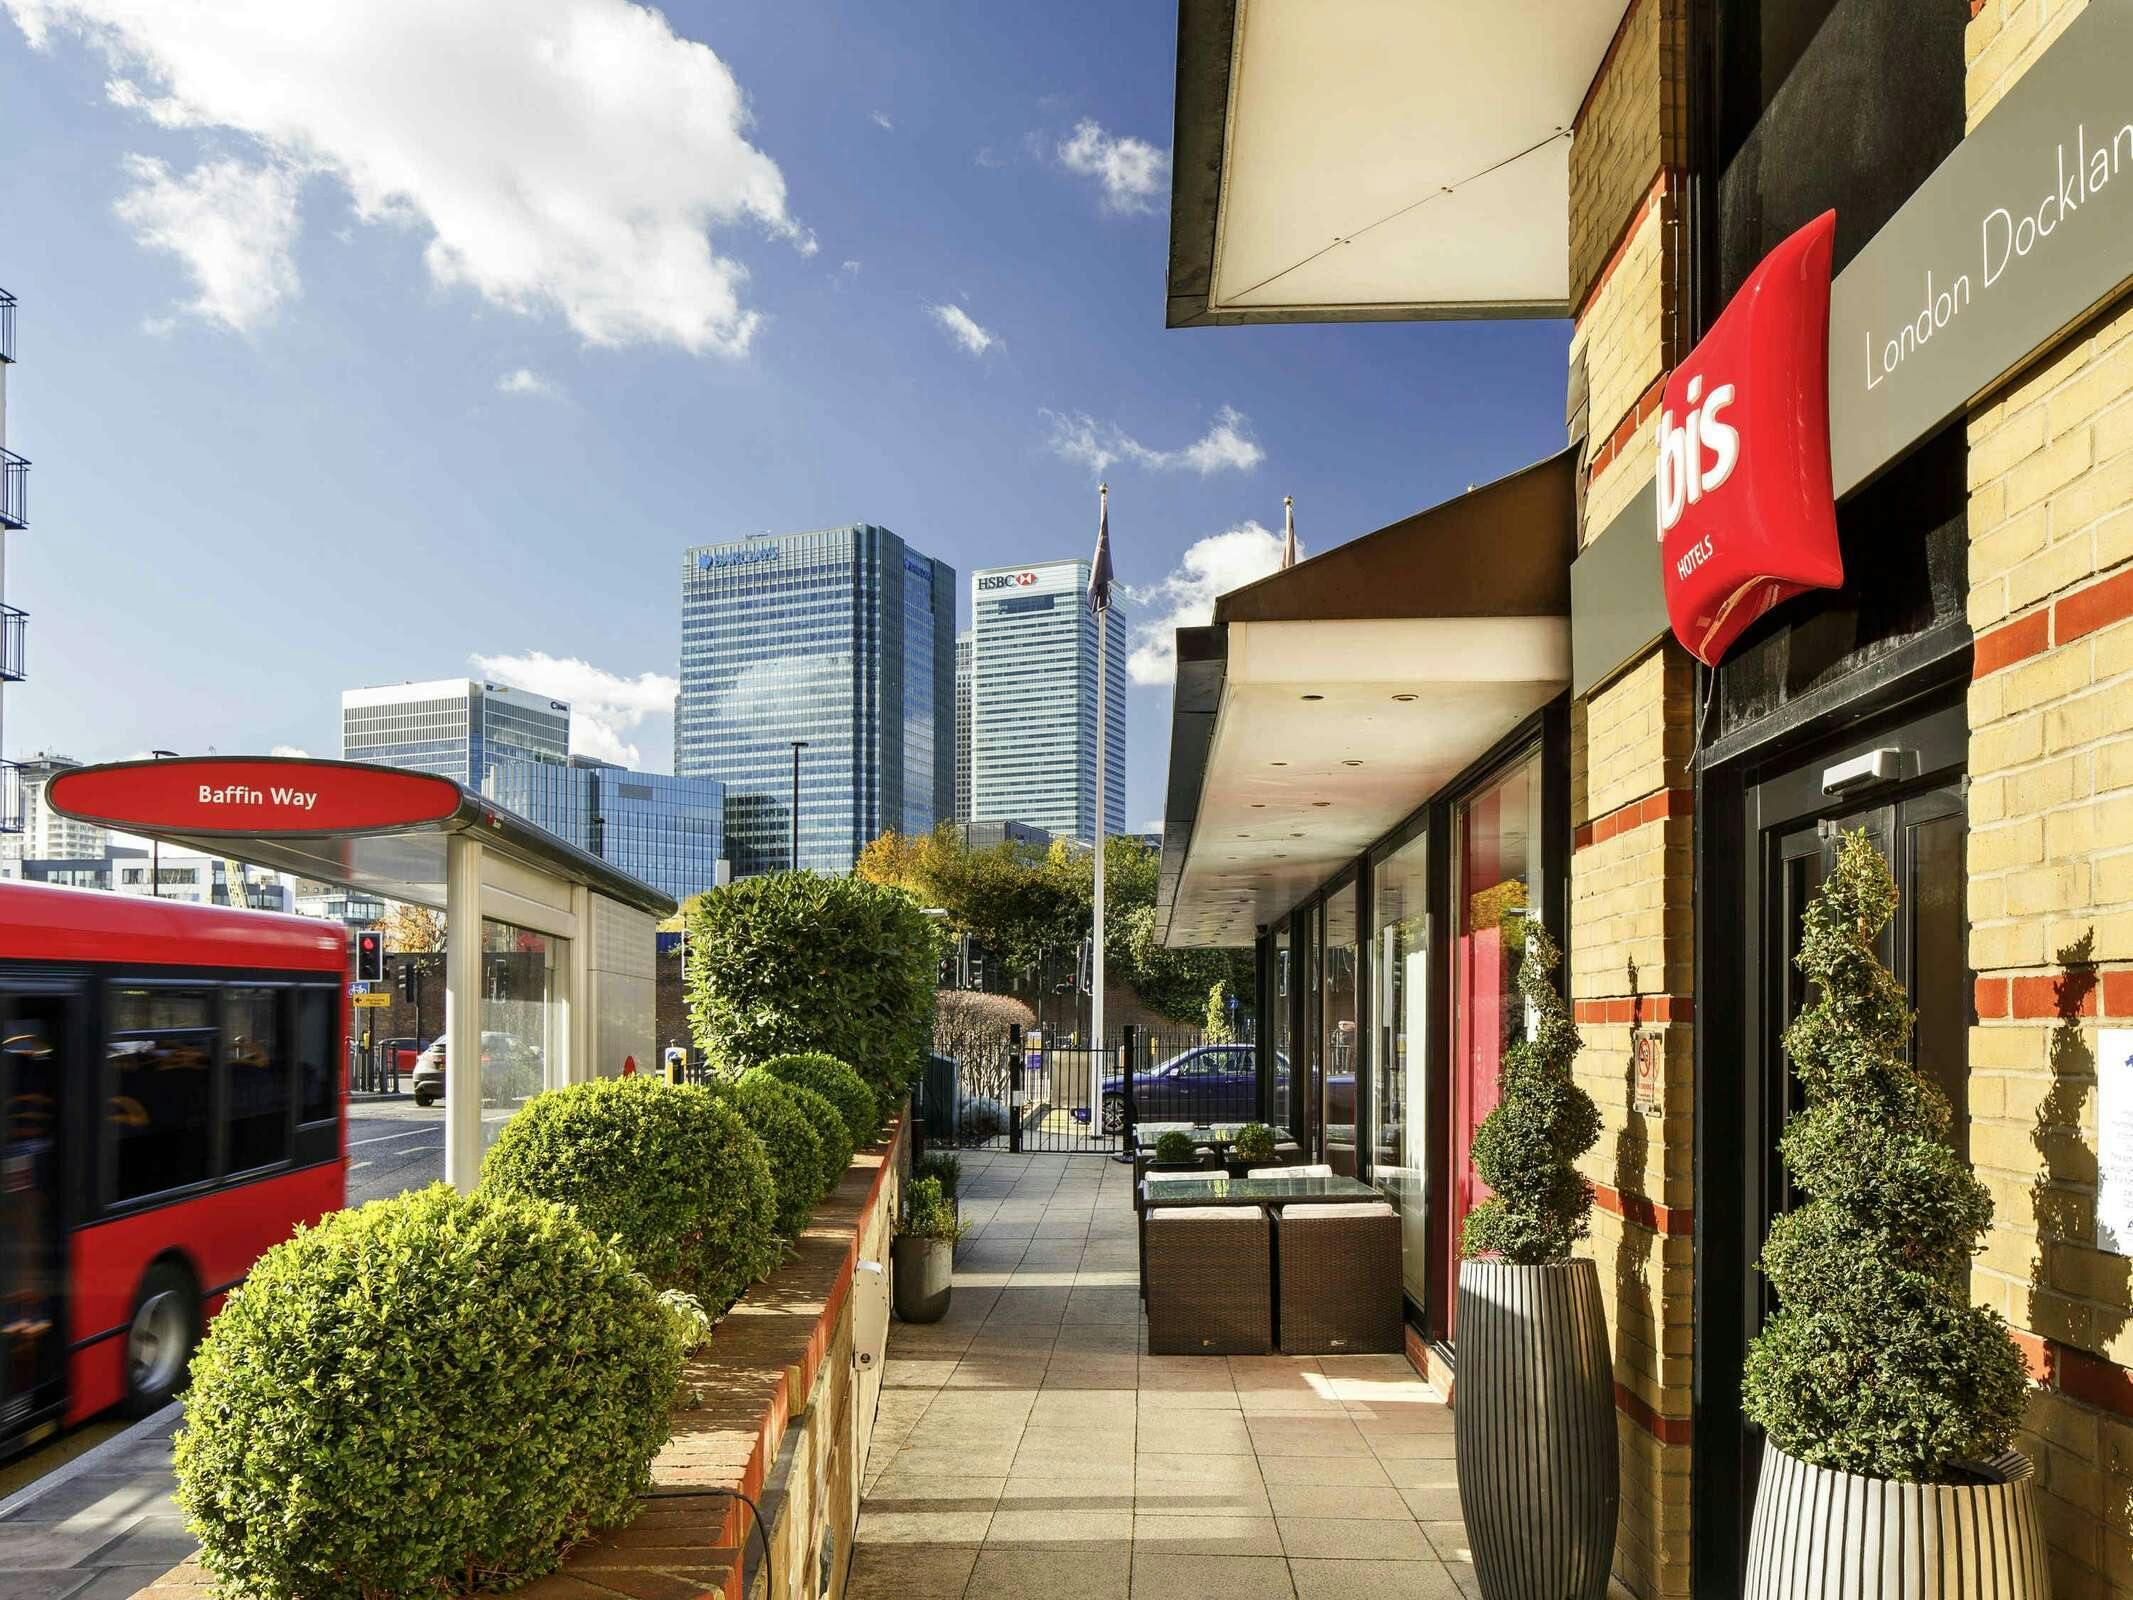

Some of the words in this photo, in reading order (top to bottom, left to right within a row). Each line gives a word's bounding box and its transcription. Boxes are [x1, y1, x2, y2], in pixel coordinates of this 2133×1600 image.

[1866, 270, 1970, 391] London
[714, 546, 777, 568] BARCLAYS
[1677, 534, 1714, 581] HOTELS
[977, 574, 1015, 590] HSBC
[199, 785, 263, 805] Baffin
[270, 787, 317, 810] Way
